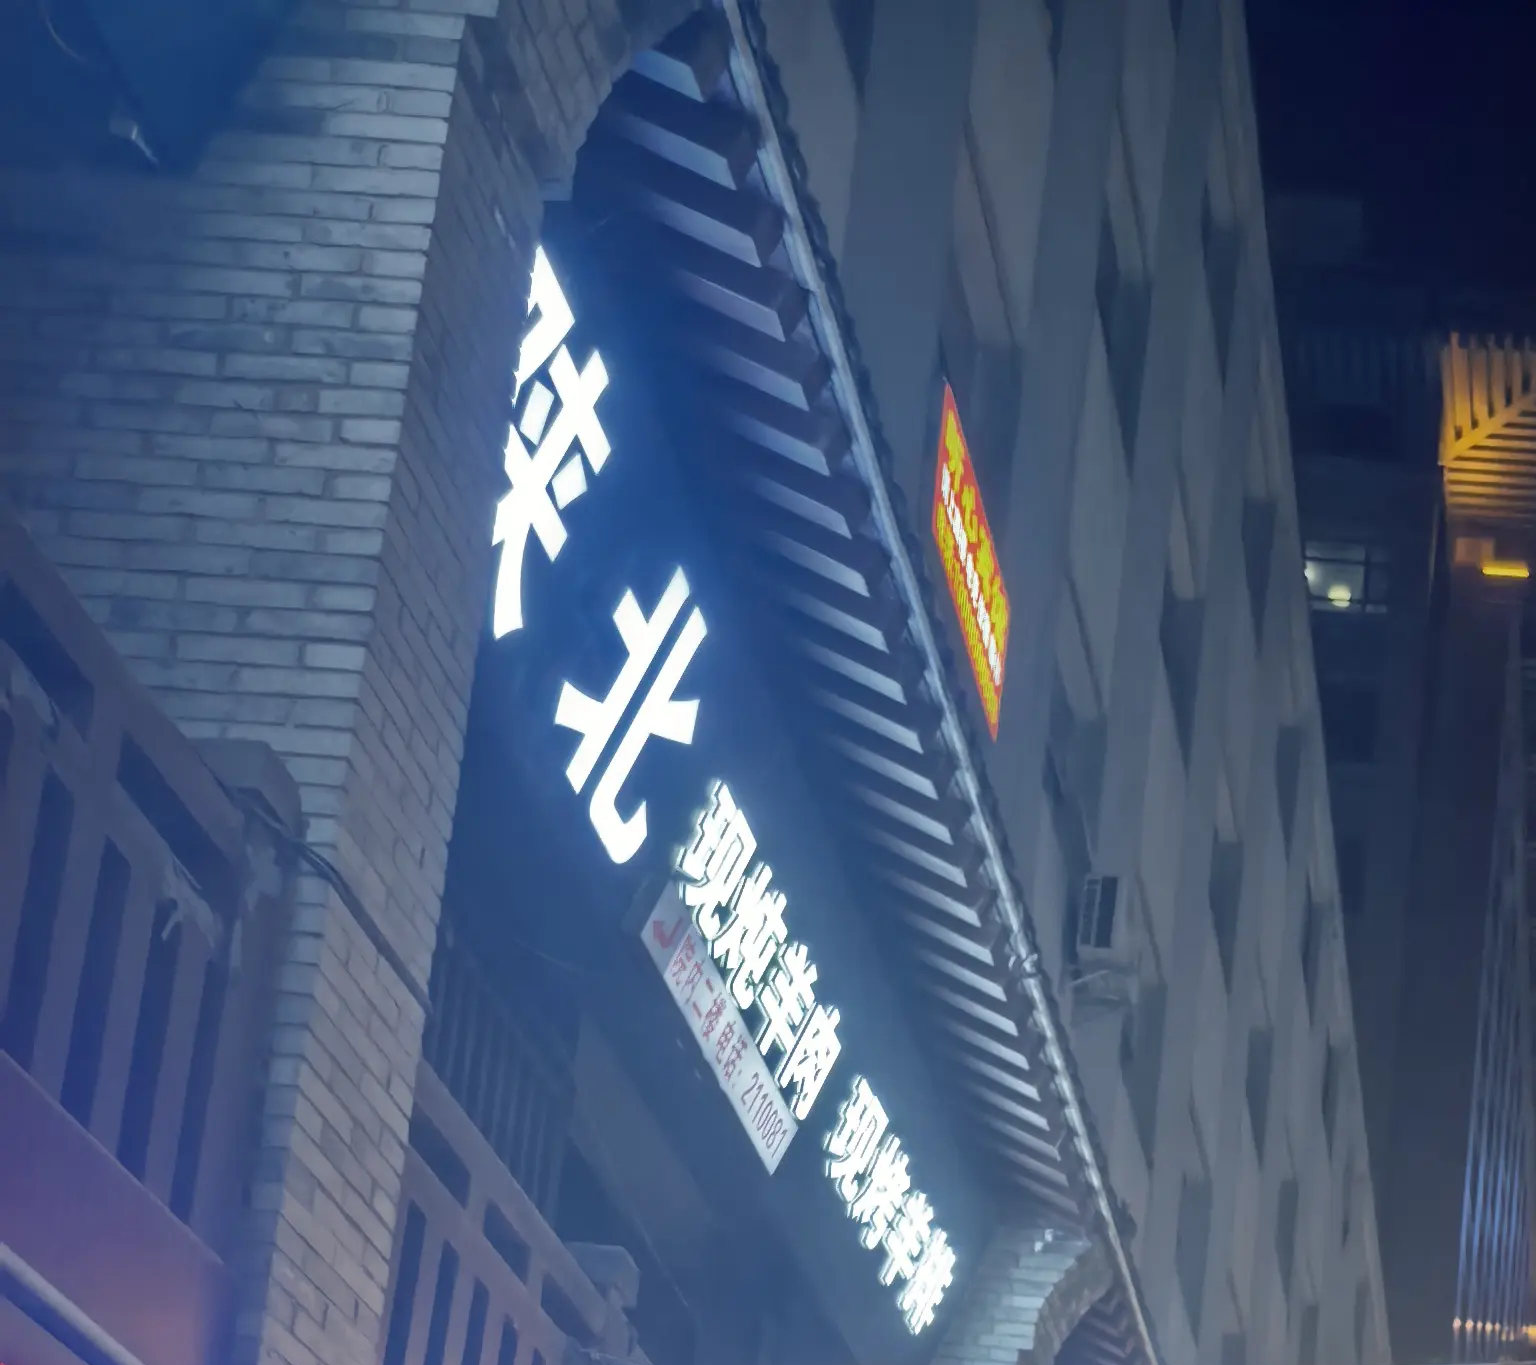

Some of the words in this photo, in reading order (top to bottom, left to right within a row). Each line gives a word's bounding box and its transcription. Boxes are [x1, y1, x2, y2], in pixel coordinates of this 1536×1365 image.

[675, 779, 842, 1120] 现炖羊肉
[825, 1074, 956, 1335] 现烤羊排
